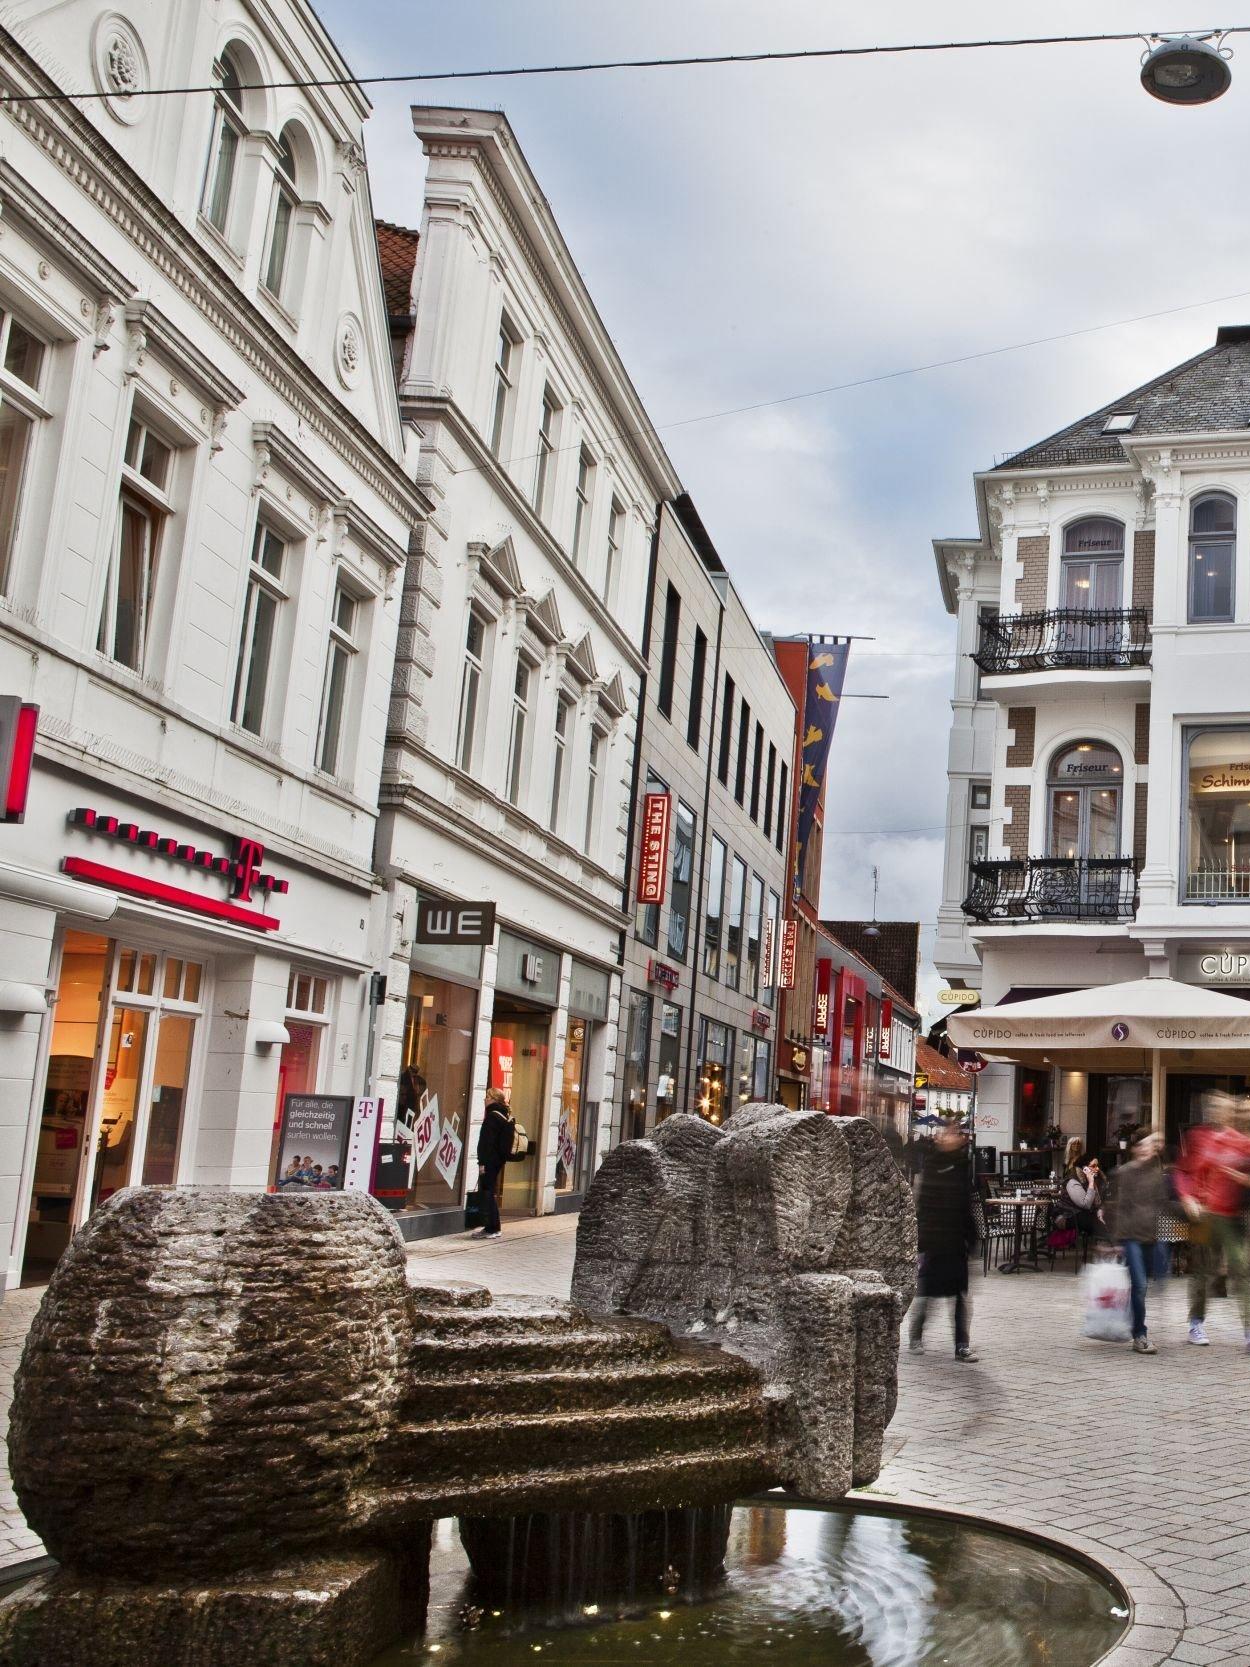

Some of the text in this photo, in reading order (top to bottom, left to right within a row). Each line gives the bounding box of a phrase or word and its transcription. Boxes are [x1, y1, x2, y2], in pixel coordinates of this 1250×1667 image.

[1079, 538, 1111, 547] Friseur
[1066, 763, 1109, 772] Friseur
[650, 800, 663, 835] THE
[236, 837, 264, 902] T
[645, 840, 661, 896] STING
[426, 910, 483, 934] WE
[524, 953, 543, 983] WE
[816, 993, 828, 1029] ESPRIT
[879, 1027, 890, 1055] ESPRIT
[289, 1110, 336, 1121] gleichzeitig
[291, 1099, 334, 1109] Für alle, die
[359, 1101, 374, 1119] T
[286, 1130, 339, 1141] surfen wollen.
[288, 1120, 333, 1130] und schnell
[417, 1111, 436, 1154] 50%
[439, 1133, 458, 1168] 20%
